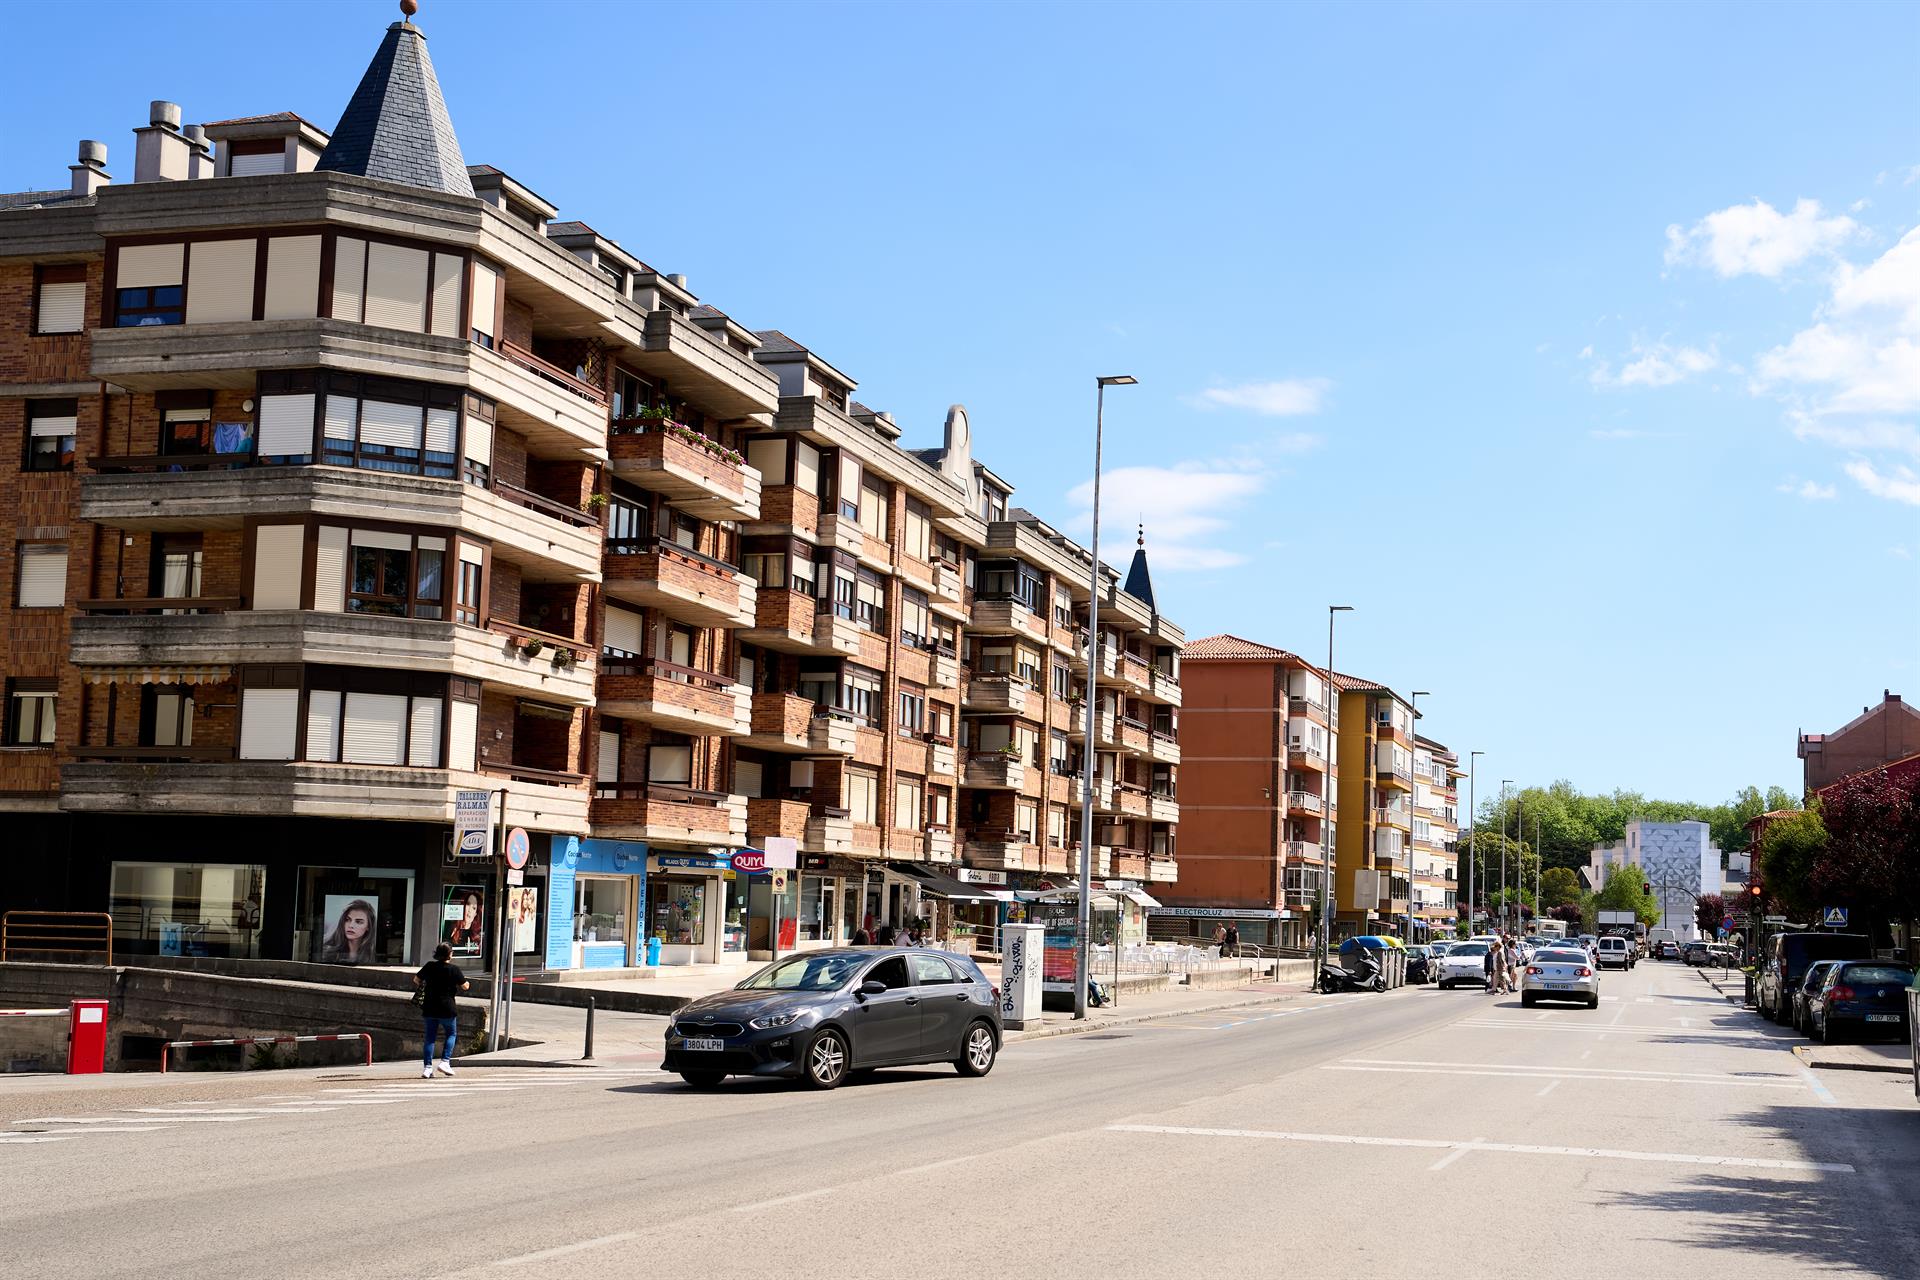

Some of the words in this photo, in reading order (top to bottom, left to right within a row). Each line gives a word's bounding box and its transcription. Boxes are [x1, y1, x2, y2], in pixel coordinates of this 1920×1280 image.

[459, 792, 487, 800] TALLERES
[1175, 908, 1222, 916] ELECTROLUZ
[687, 1040, 705, 1050] 3804
[707, 1040, 722, 1050] LPH
